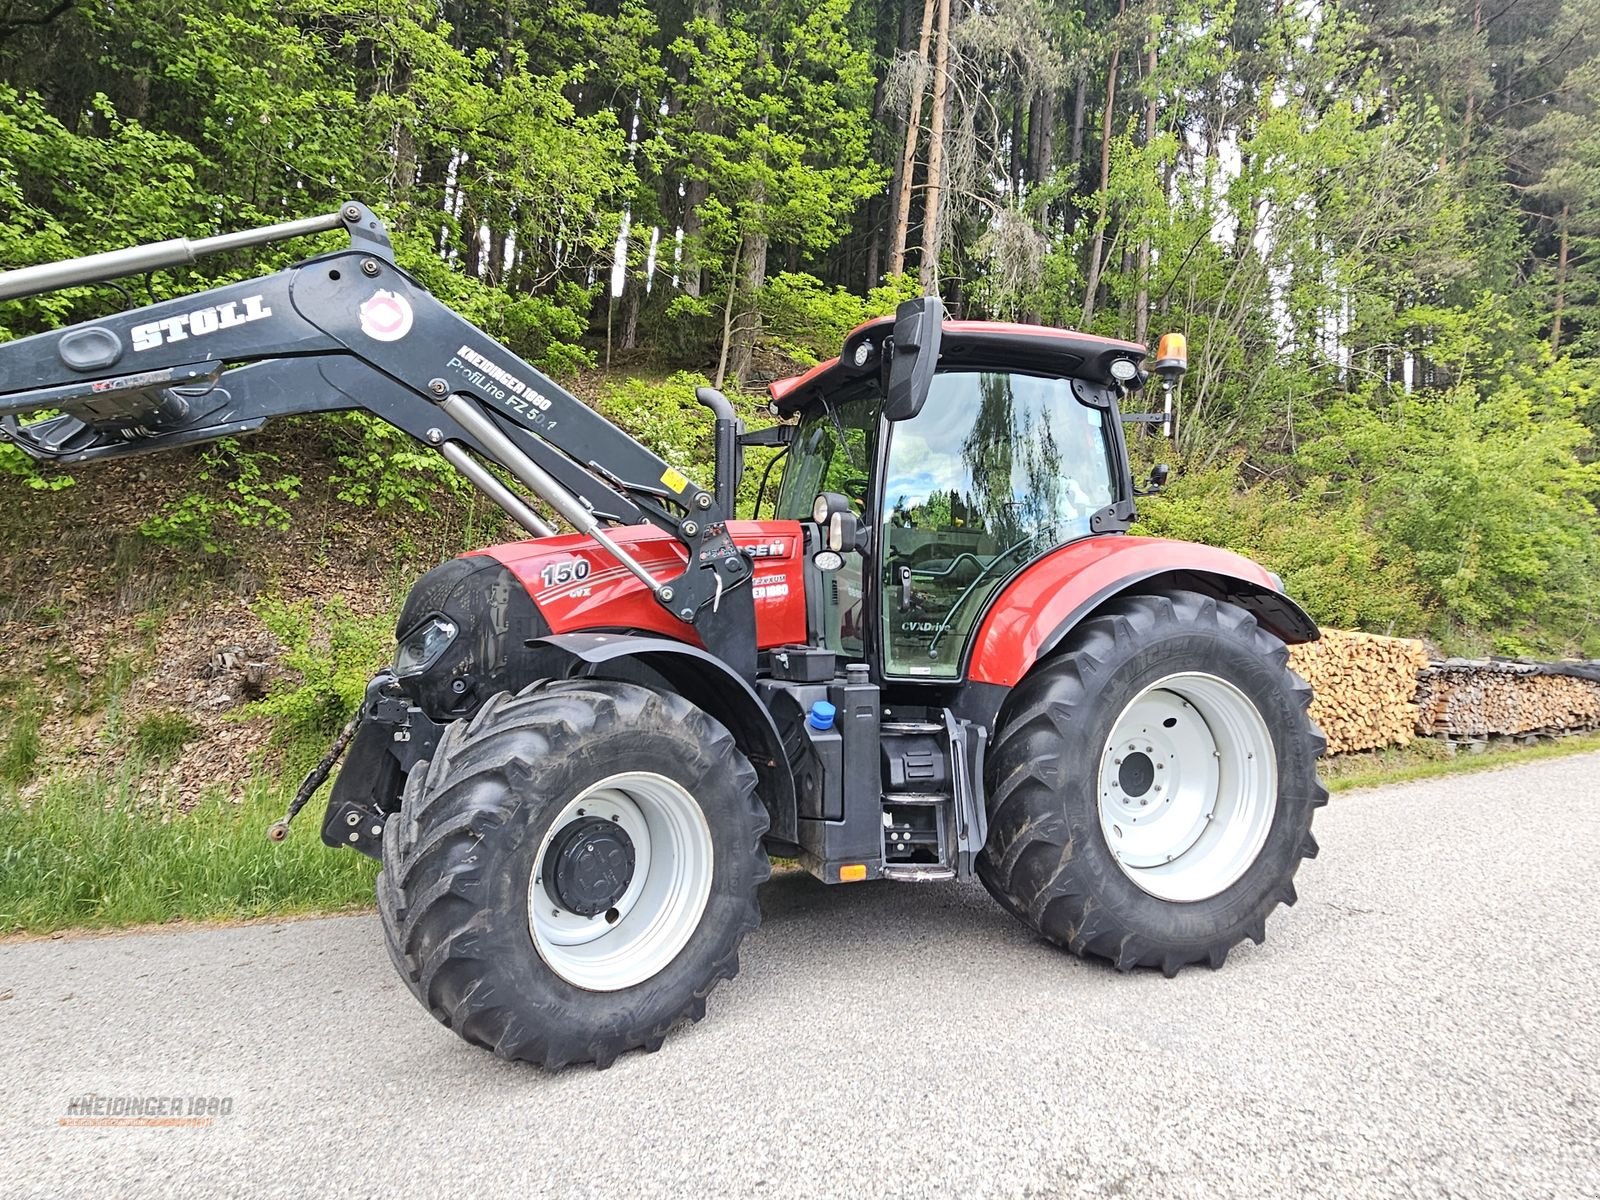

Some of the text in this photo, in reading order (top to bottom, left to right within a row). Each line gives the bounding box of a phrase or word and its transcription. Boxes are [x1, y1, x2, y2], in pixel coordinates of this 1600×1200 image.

[131, 295, 272, 351] STOLL
[505, 395, 529, 413] FZ
[541, 559, 591, 588] 150
